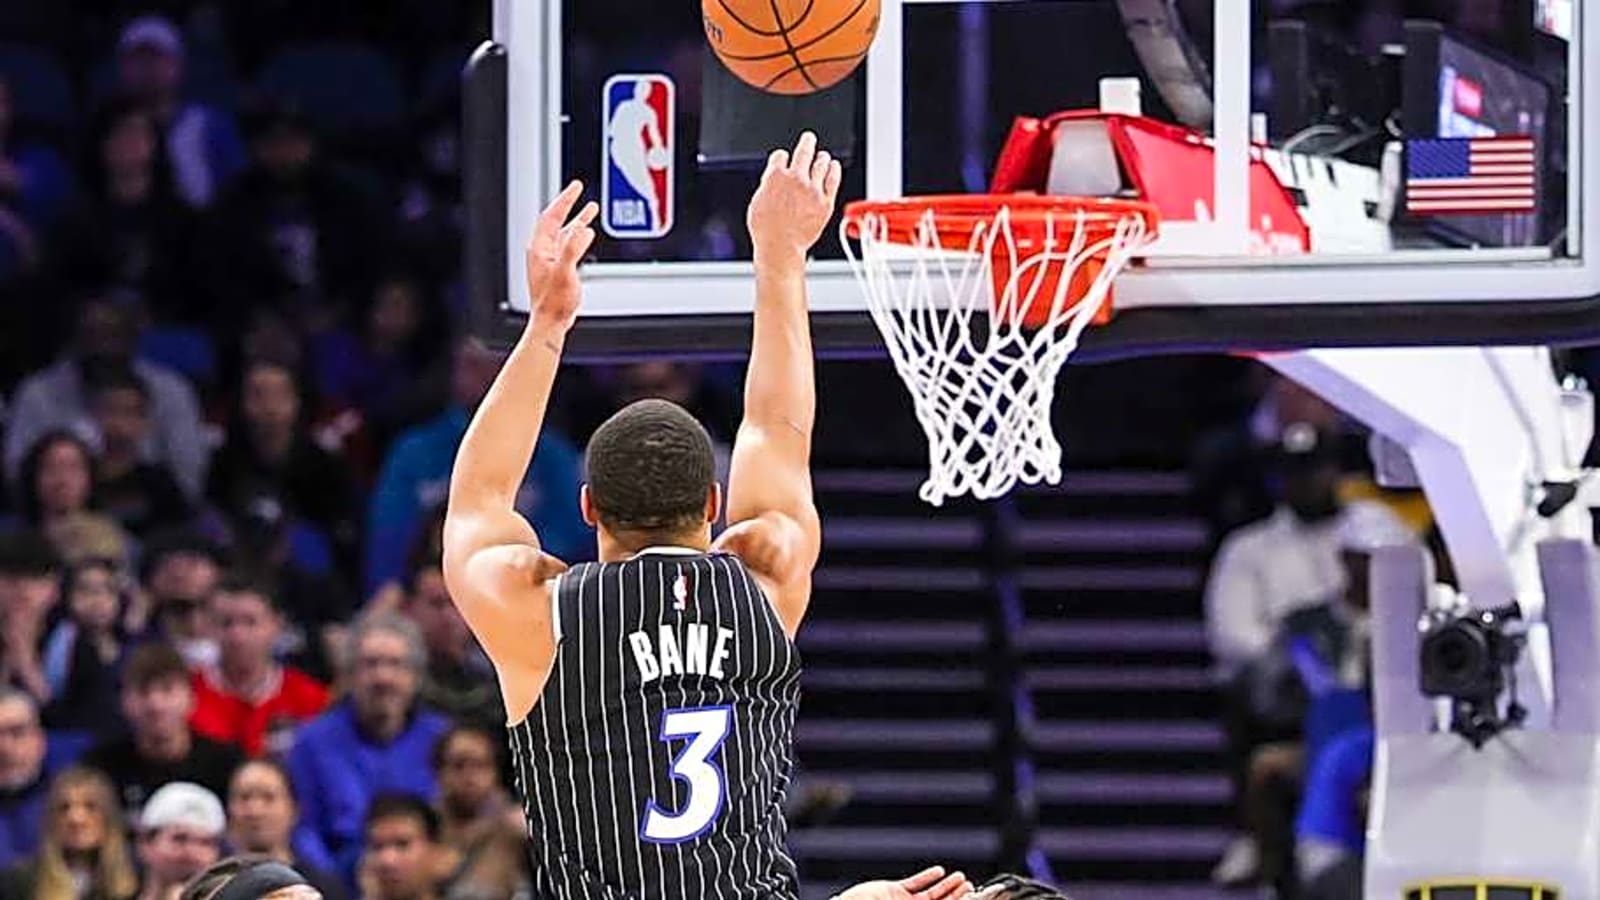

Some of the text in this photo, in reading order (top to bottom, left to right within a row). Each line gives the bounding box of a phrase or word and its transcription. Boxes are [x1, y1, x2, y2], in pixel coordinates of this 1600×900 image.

[612, 199, 647, 226] NBA
[628, 622, 734, 683] BANE
[640, 704, 732, 844] 3
